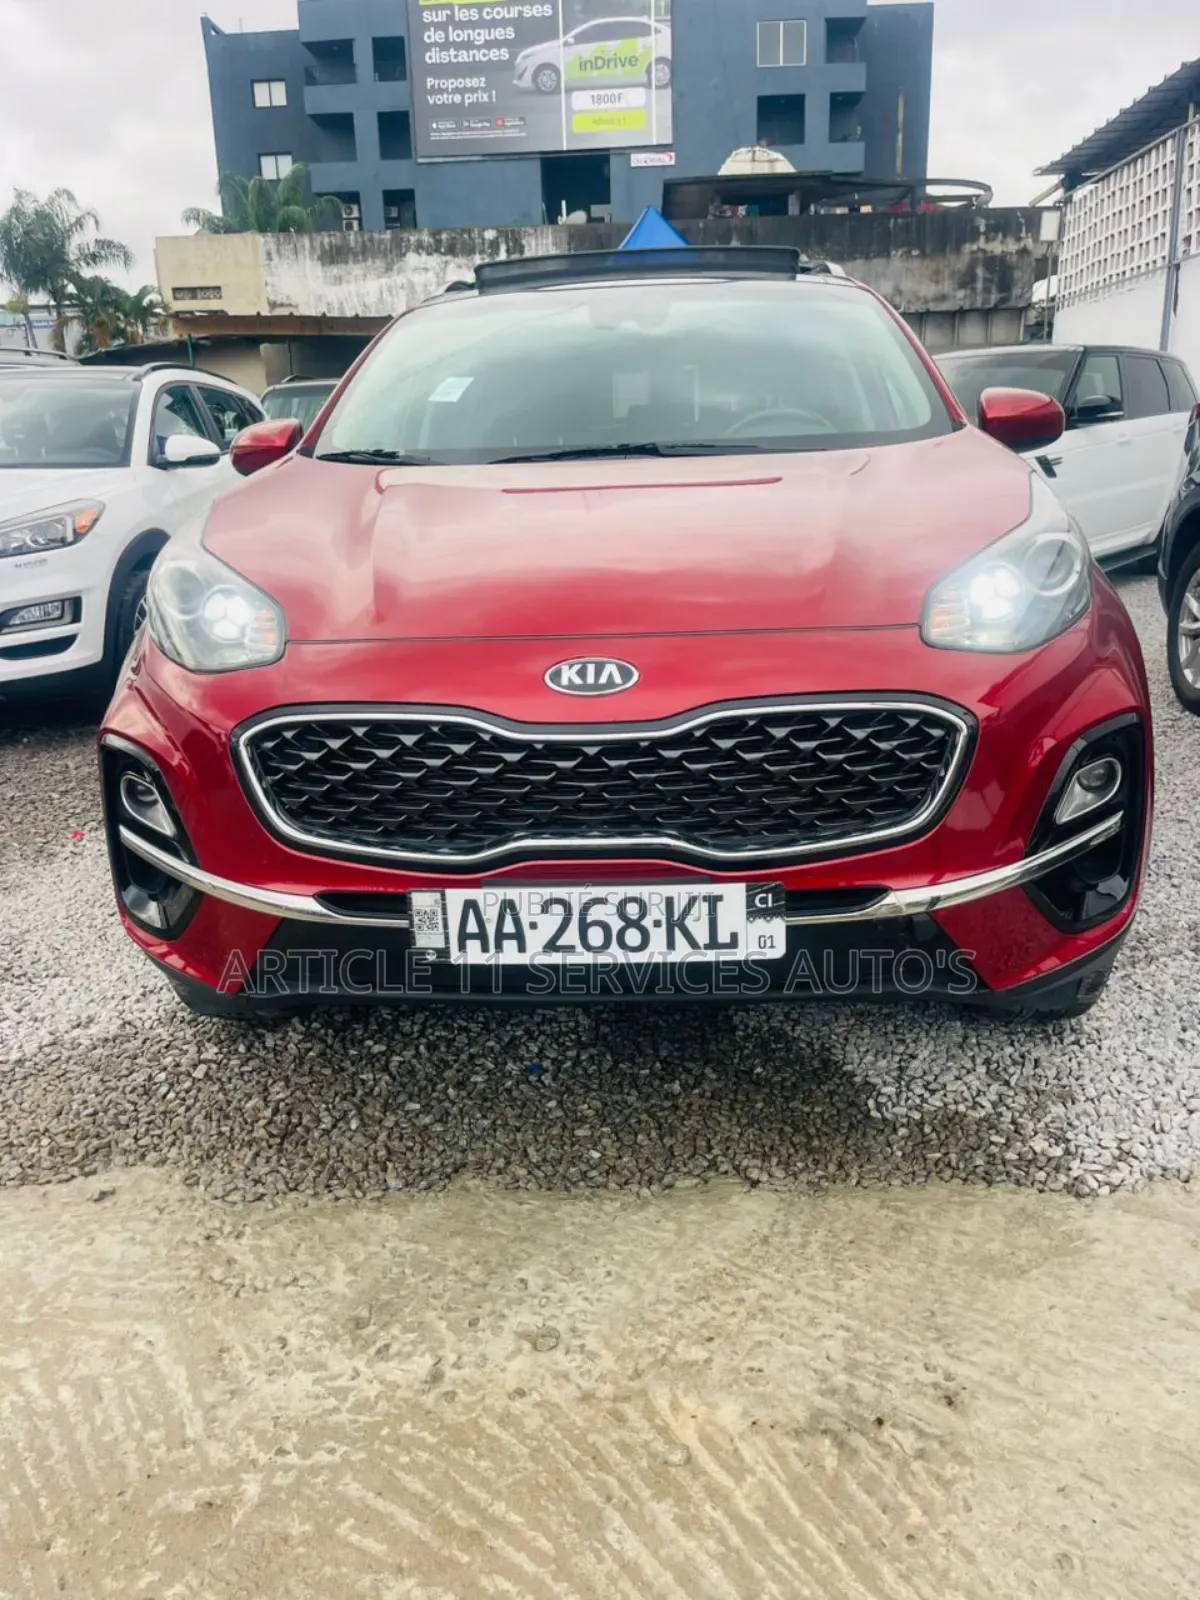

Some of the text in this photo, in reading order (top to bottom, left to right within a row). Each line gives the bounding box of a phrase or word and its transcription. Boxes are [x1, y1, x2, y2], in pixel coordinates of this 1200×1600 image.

[422, 4, 553, 23] sur les courses
[423, 25, 515, 45] de longues
[424, 47, 509, 64] distances
[578, 53, 640, 72] inDrive
[426, 77, 486, 92] Proposez
[427, 92, 462, 105] votre
[464, 90, 490, 107] prix
[560, 663, 623, 686] KIA
[754, 893, 774, 909] CI
[757, 934, 777, 950] 01
